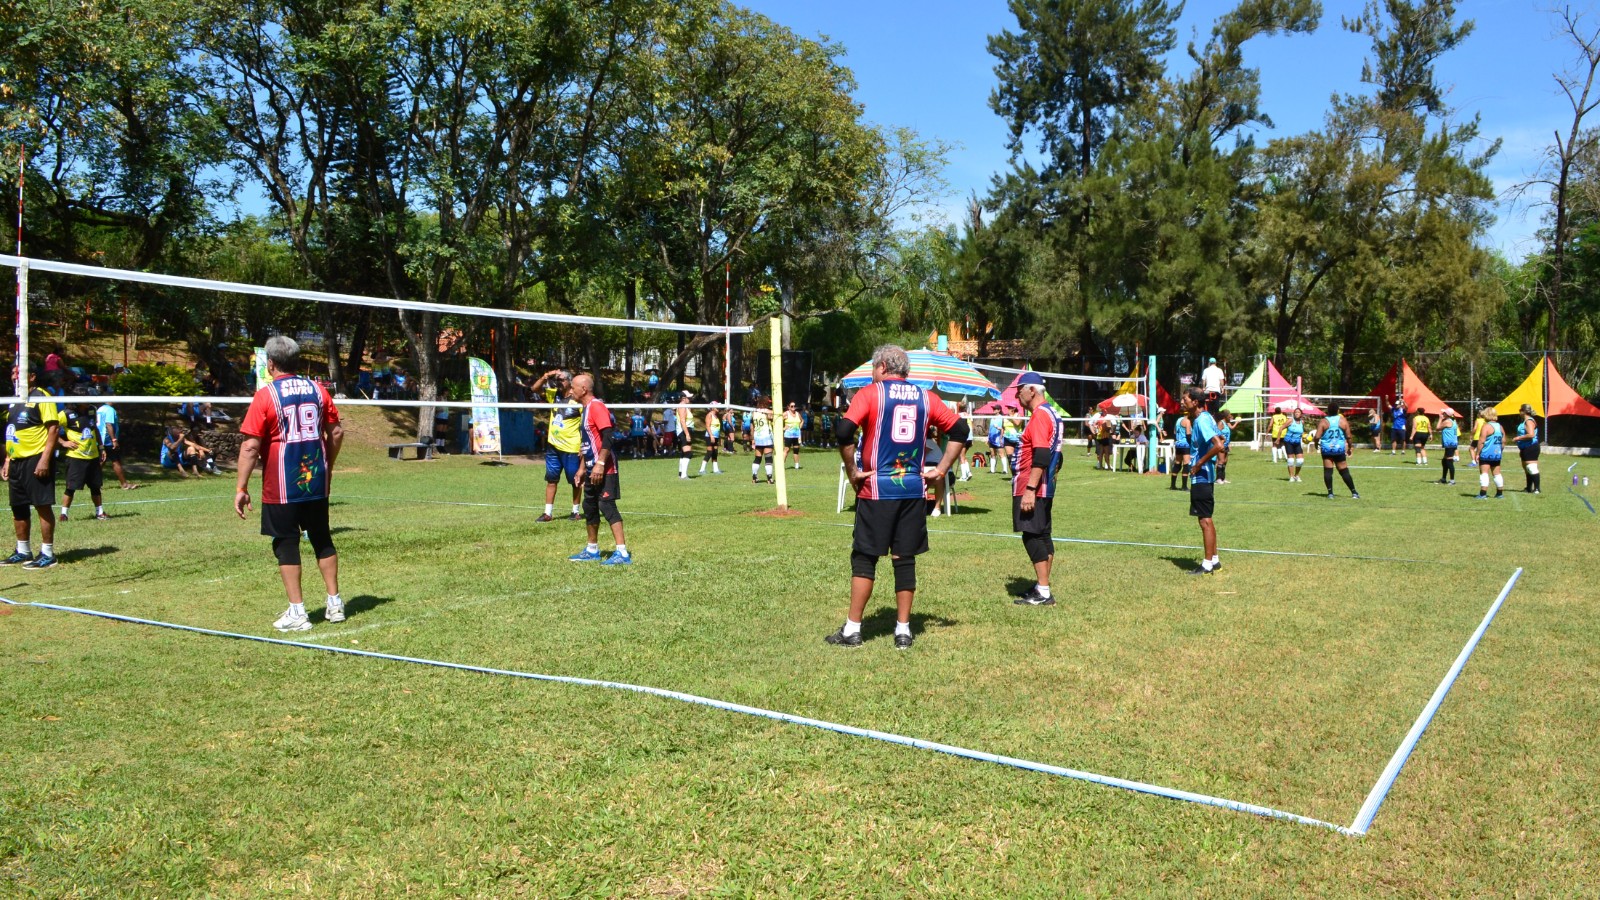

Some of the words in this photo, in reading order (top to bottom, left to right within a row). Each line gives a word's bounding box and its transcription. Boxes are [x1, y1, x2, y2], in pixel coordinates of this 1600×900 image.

[281, 386, 313, 397] BAURU
[890, 383, 917, 391] ATIBA
[889, 390, 919, 400] BAURU
[283, 403, 319, 443] 19
[755, 418, 764, 427] 16
[891, 404, 917, 443] 6
[1328, 429, 1340, 440] 23
